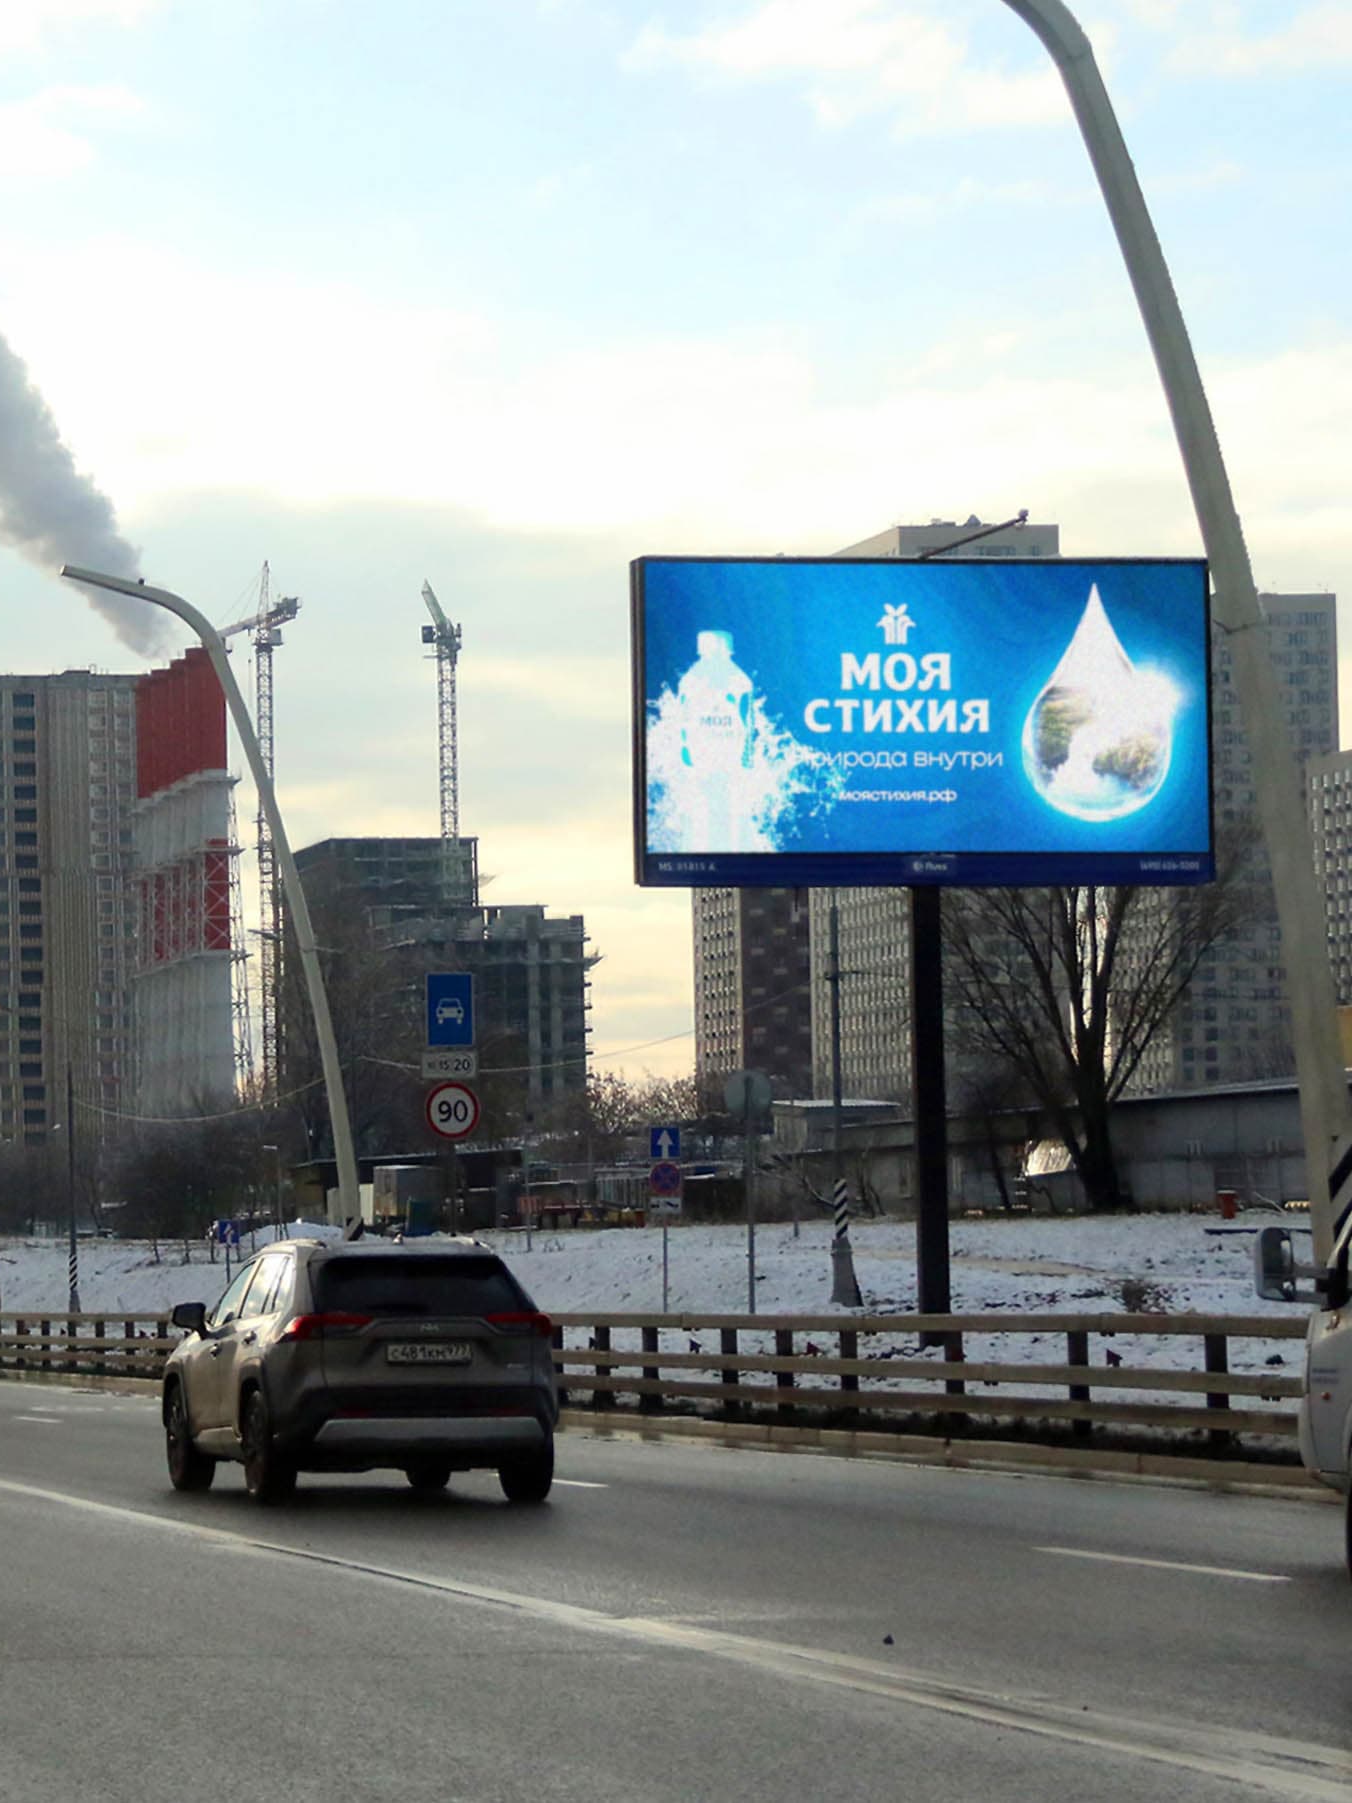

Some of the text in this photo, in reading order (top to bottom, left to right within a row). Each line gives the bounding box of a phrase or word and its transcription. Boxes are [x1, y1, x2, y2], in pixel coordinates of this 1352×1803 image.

[840, 652, 951, 691] МОЯ
[803, 698, 990, 733] СТИХИЯ
[793, 751, 1004, 770] рирода внутри
[438, 1100, 468, 1122] 90
